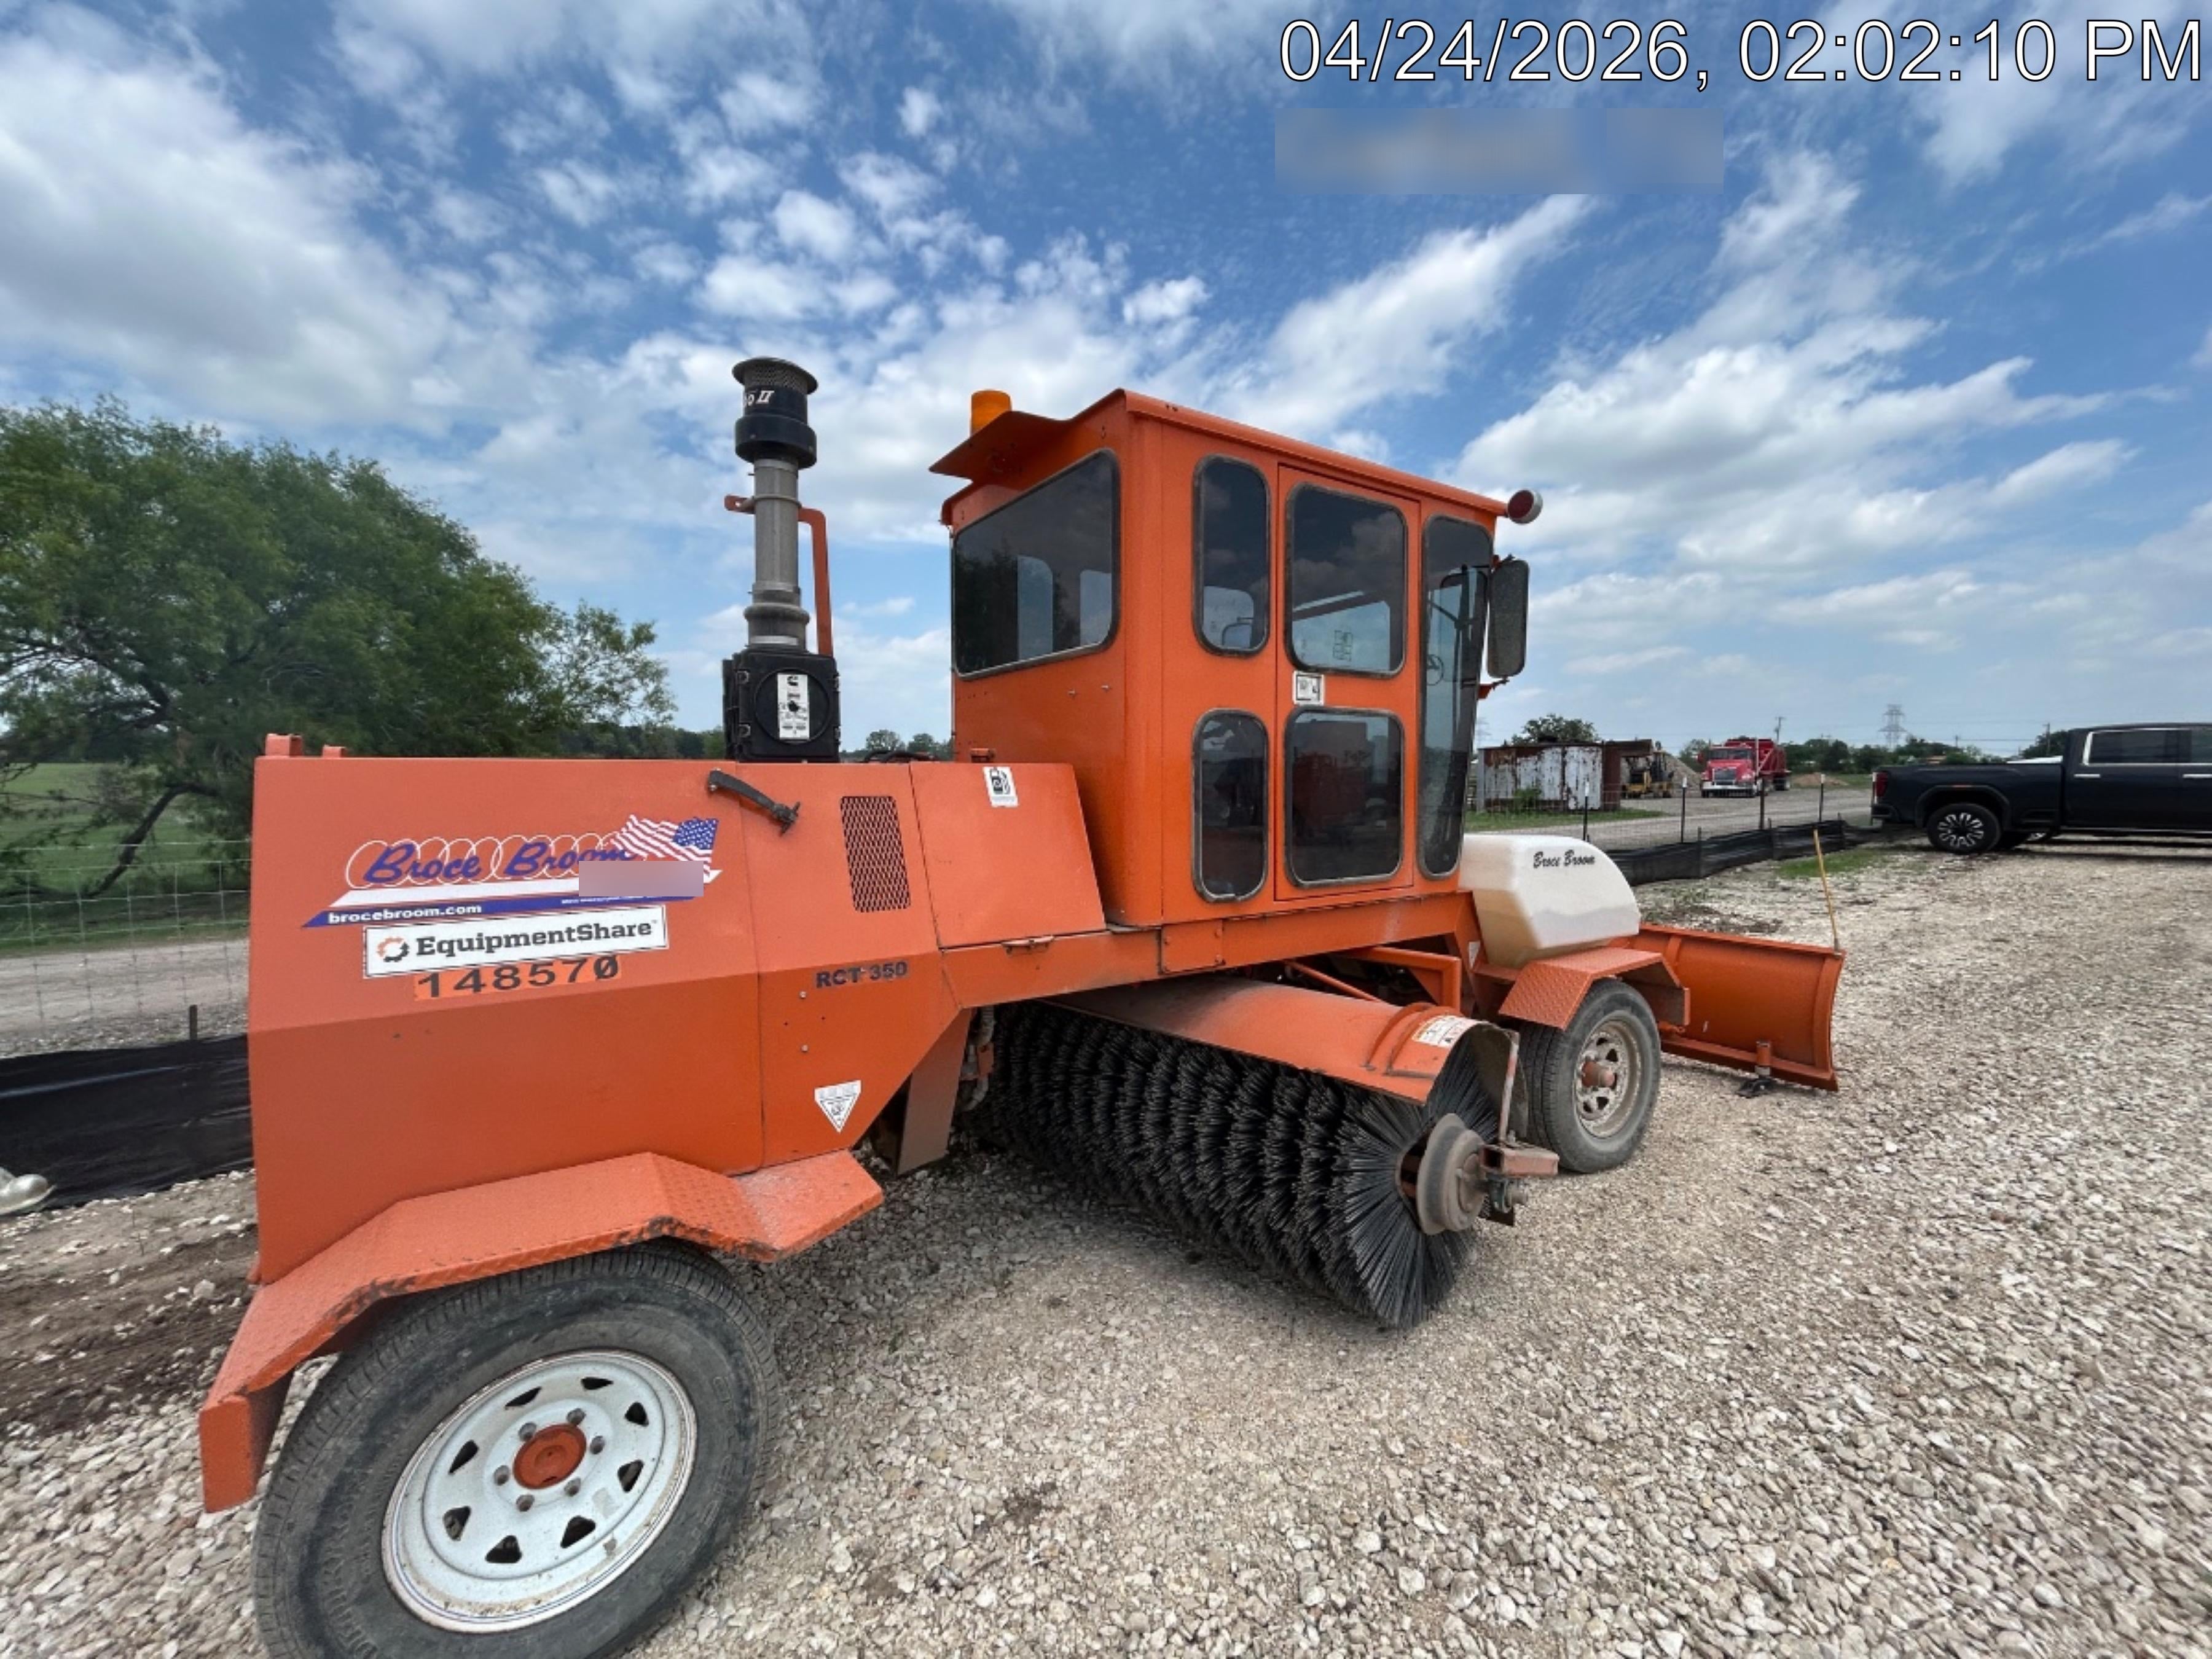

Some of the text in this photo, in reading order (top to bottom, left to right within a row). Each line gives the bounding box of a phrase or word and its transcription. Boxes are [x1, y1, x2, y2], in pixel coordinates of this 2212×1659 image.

[363, 840, 637, 884] Broce Broom
[327, 904, 482, 924] brocebroom.com
[416, 922, 653, 957] EquipmentShare
[417, 953, 621, 998] 148570
[815, 961, 908, 988] RCT 350
